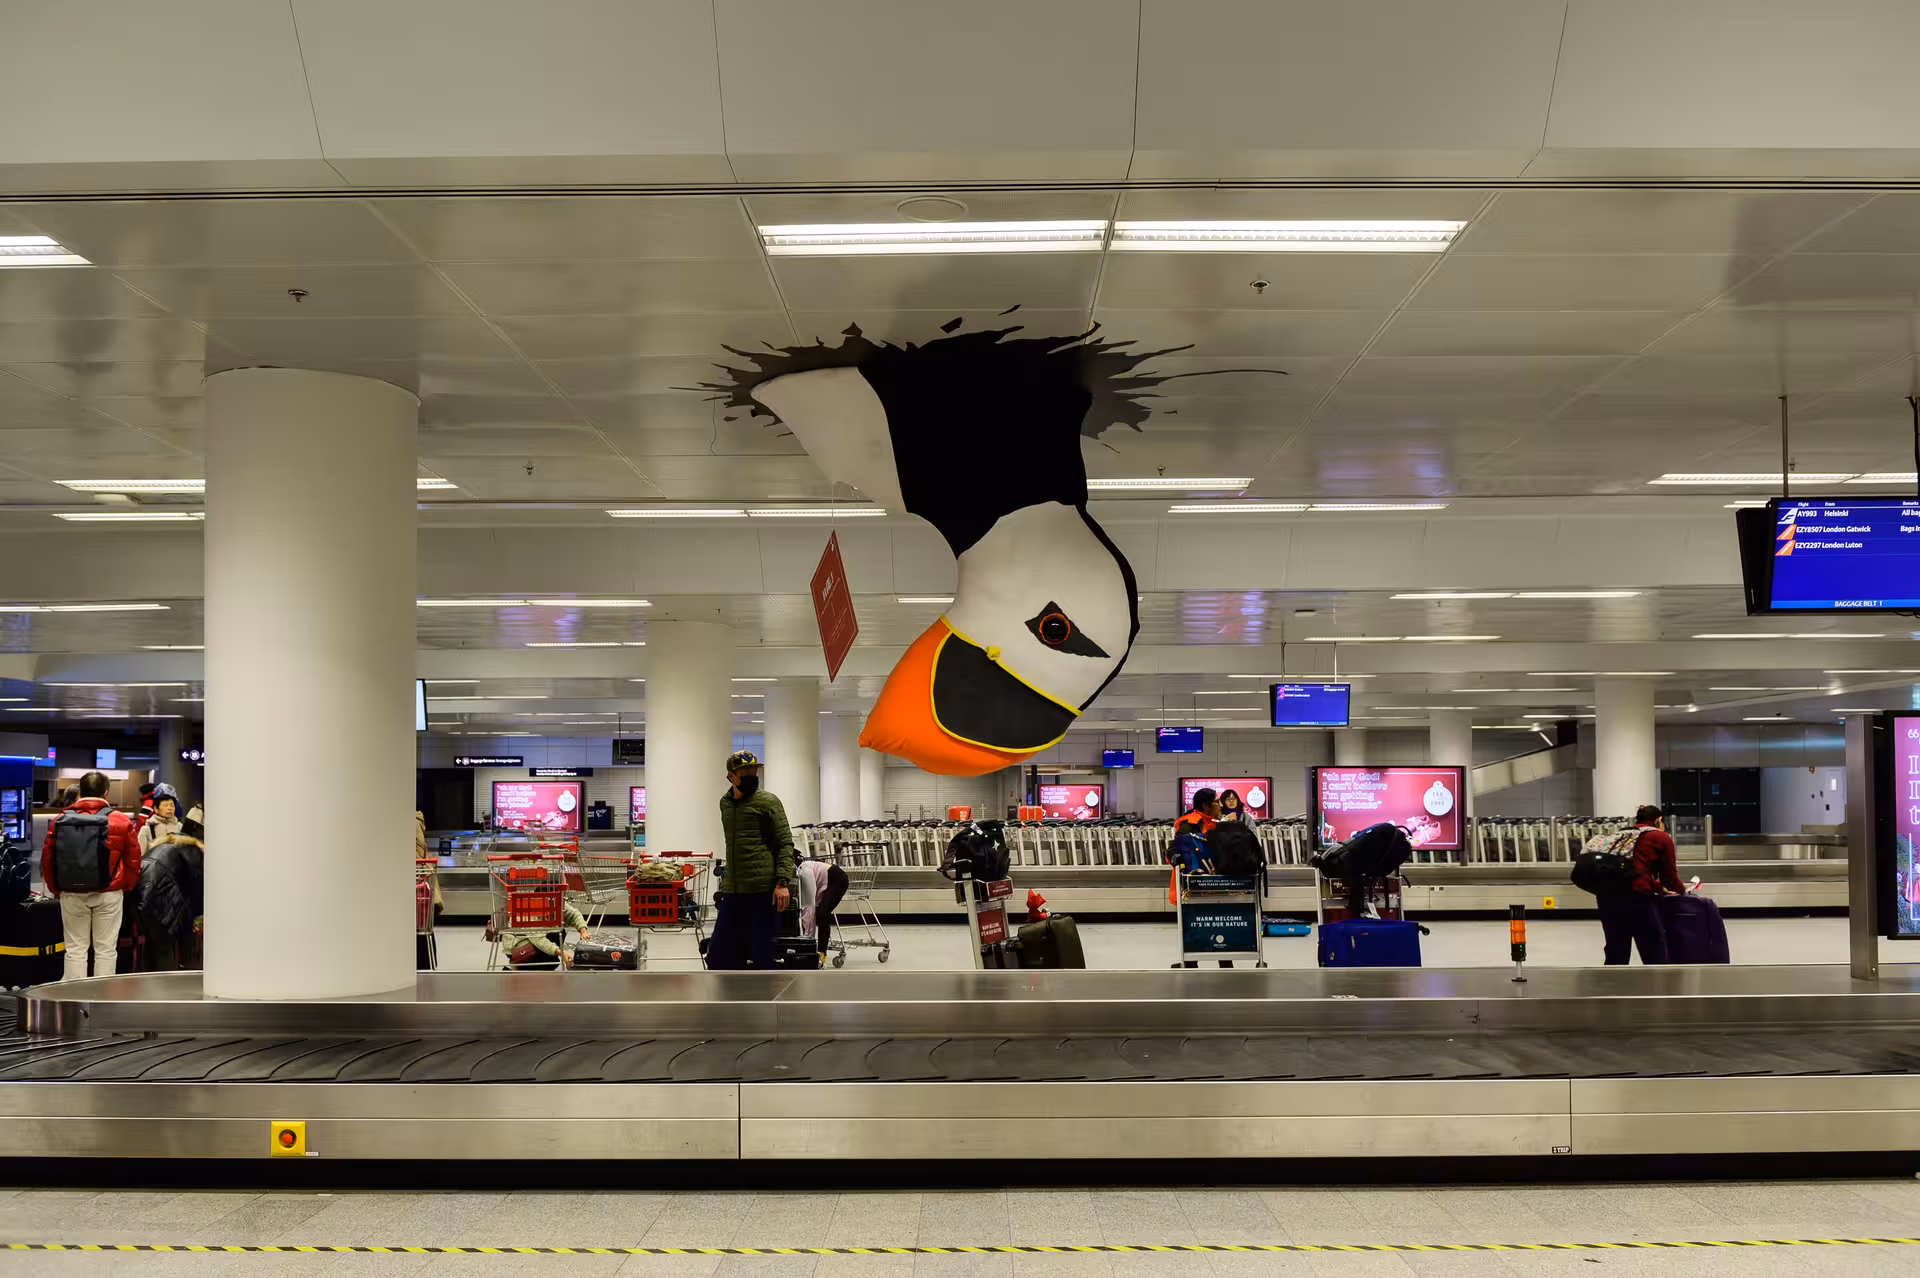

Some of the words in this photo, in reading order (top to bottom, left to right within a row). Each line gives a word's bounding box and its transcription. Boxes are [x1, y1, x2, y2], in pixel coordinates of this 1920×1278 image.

[1824, 509, 1849, 517] Helsinki
[1900, 525, 1915, 533] Bags
[1322, 800, 1341, 809] two
